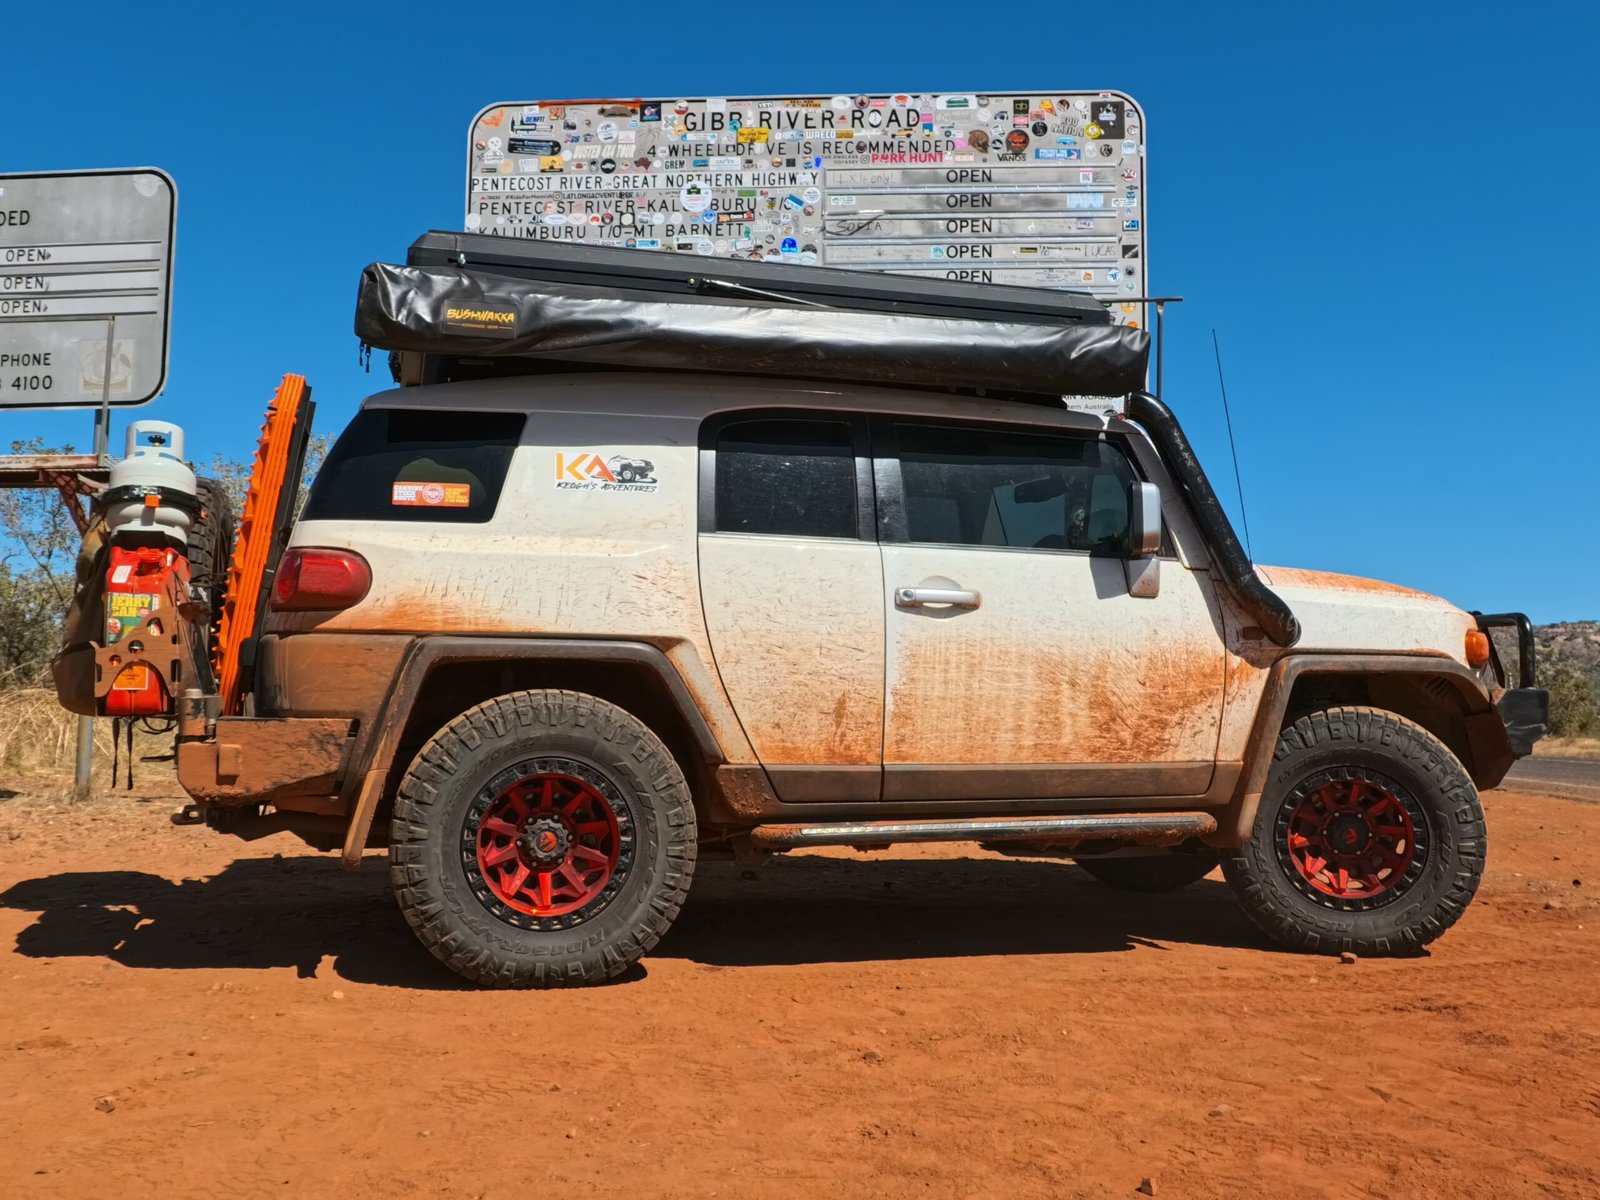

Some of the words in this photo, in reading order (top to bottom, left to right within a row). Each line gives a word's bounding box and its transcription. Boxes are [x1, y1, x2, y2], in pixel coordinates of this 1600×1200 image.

[684, 112, 743, 131] GIBB
[760, 110, 834, 130] RIVER
[852, 109, 920, 128] ROAD
[805, 130, 836, 139] WAECO
[647, 145, 656, 157] 4
[668, 144, 726, 157] WHEEL
[736, 142, 787, 156] DRVE
[797, 142, 813, 155] IS
[822, 140, 955, 154] RECMMENDED
[910, 152, 943, 163] HUNT
[471, 177, 552, 191] PENTECOST
[752, 172, 819, 186] HIGHWY
[946, 169, 992, 183] OPEN
[479, 201, 576, 215] PENTECST
[946, 194, 992, 208] OPEN
[665, 223, 744, 237] BARNETT
[946, 219, 992, 233] OPEN
[6, 249, 47, 262] OPEN
[946, 245, 992, 259] OPEN
[4, 276, 44, 290] OPEN
[946, 270, 992, 283] OPEN
[1, 300, 42, 313] OPEN
[446, 308, 515, 324] BUSHWAKKA
[11, 375, 53, 390] 4100
[556, 481, 597, 490] KEOGH'S
[601, 483, 657, 493] ADVENTURES
[111, 596, 151, 607] JERRY
[111, 606, 137, 618] CAN
